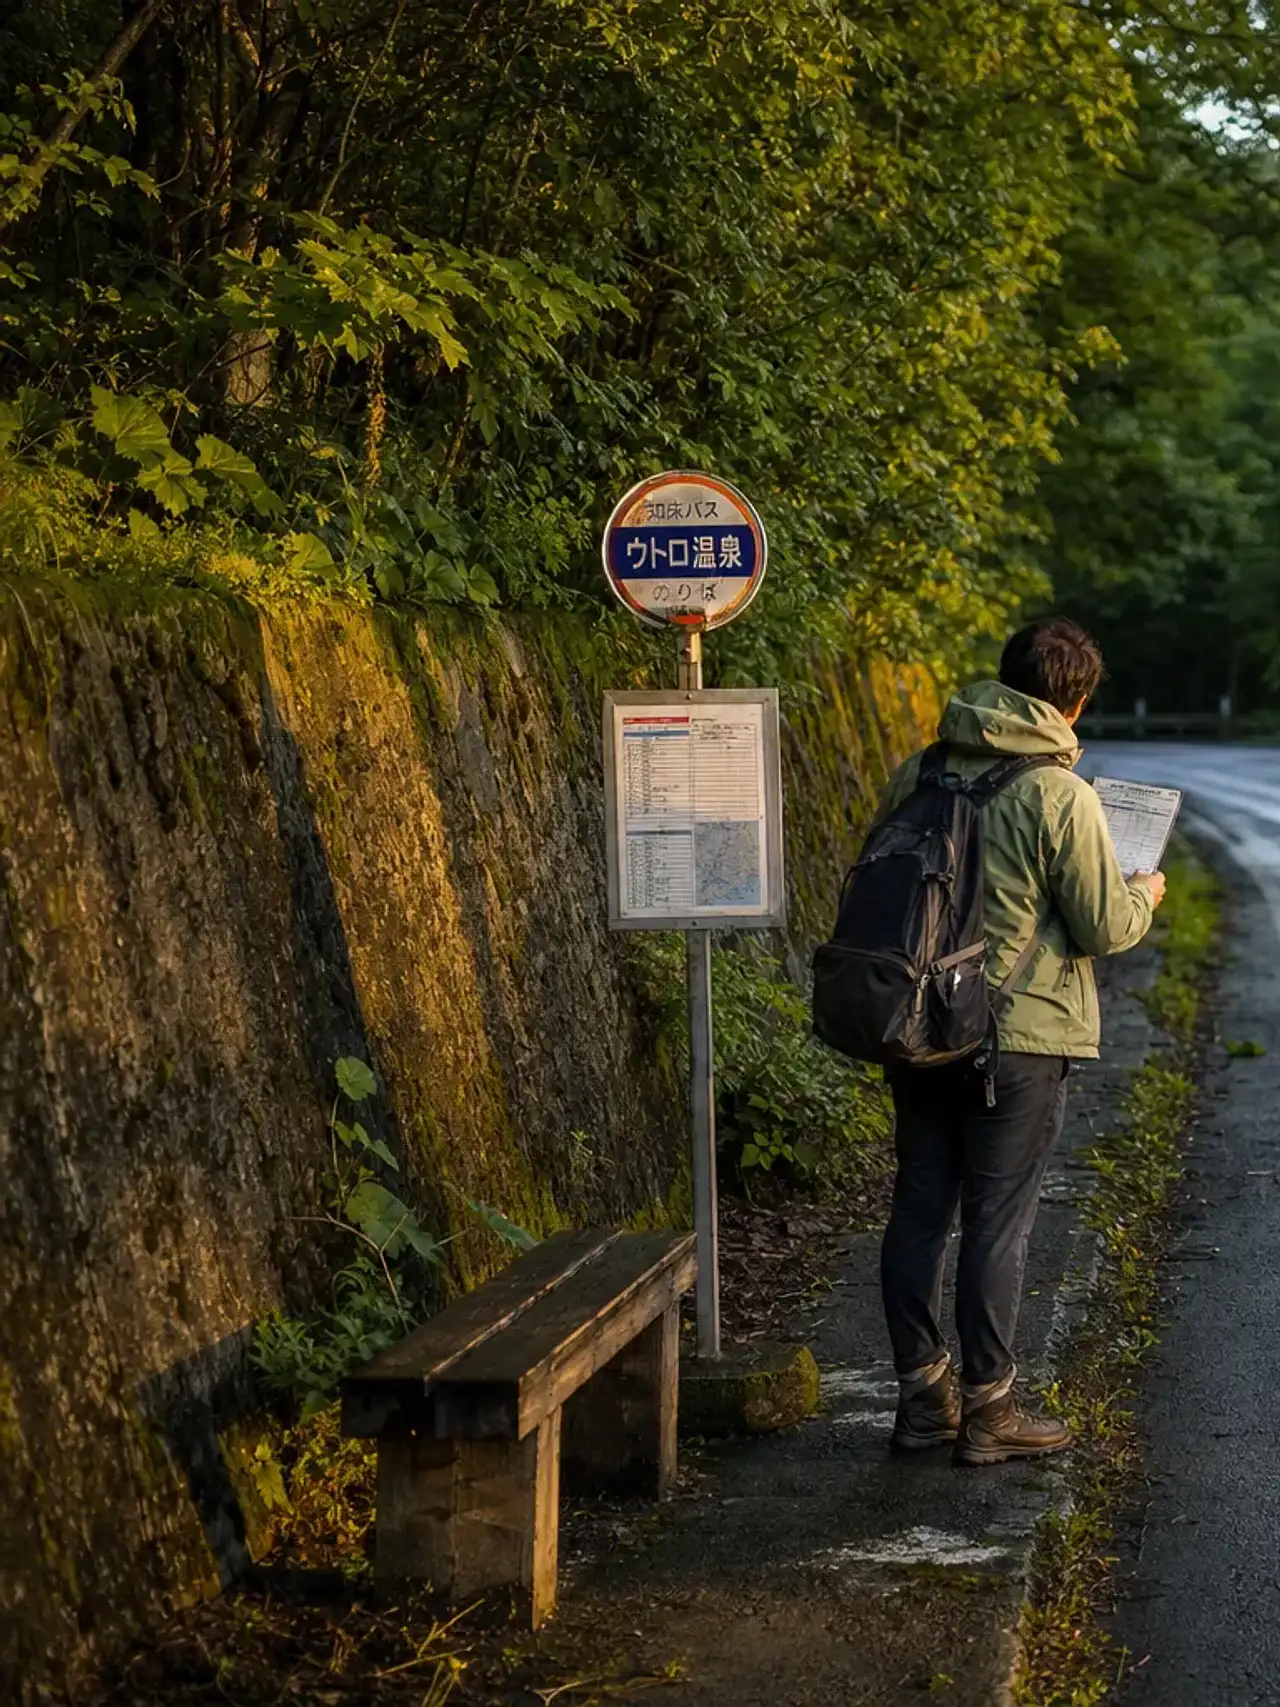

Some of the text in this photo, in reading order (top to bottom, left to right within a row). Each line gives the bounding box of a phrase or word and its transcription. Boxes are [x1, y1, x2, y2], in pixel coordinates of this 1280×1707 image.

[626, 534, 743, 569] ウトロ温泉
